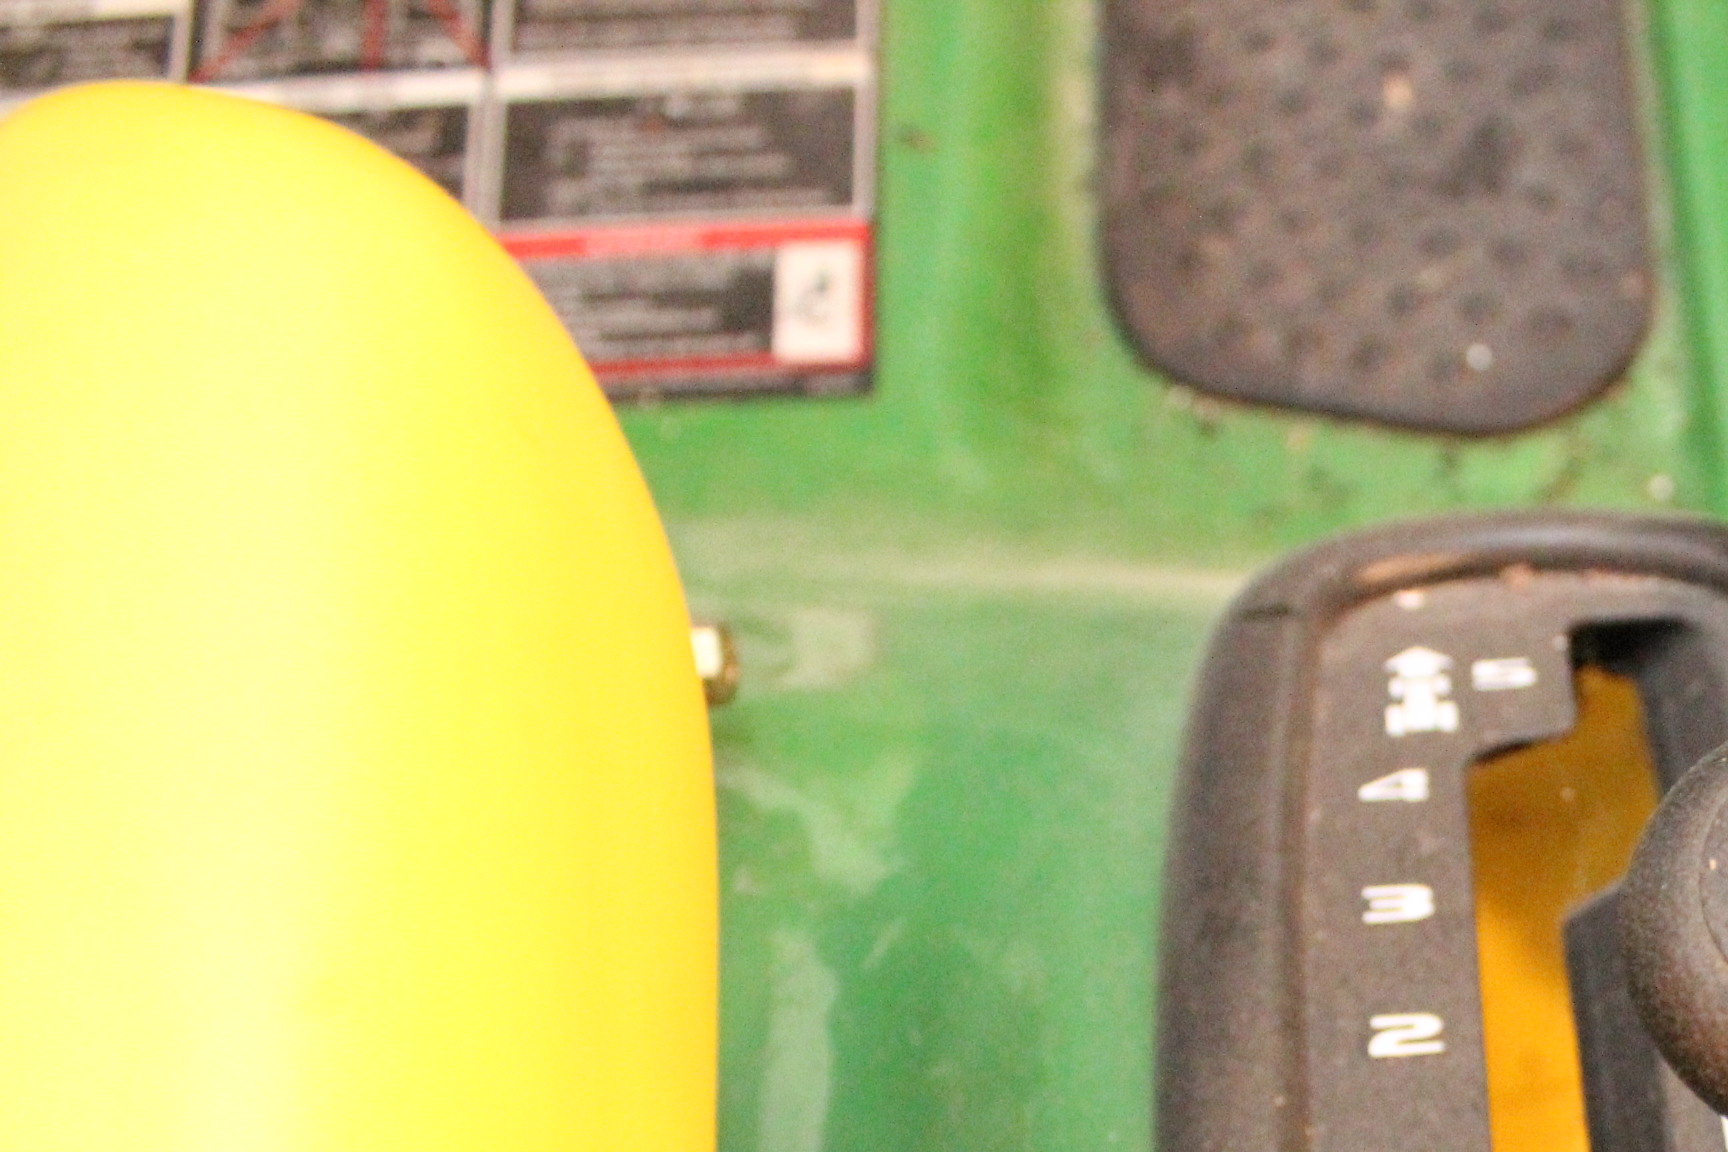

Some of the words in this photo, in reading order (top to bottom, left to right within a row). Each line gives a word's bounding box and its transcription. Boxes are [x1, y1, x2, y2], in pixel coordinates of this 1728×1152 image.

[1471, 657, 1537, 691] 5
[1357, 768, 1430, 802] 4
[1360, 884, 1435, 924] 3
[1367, 1012, 1446, 1059] 2
